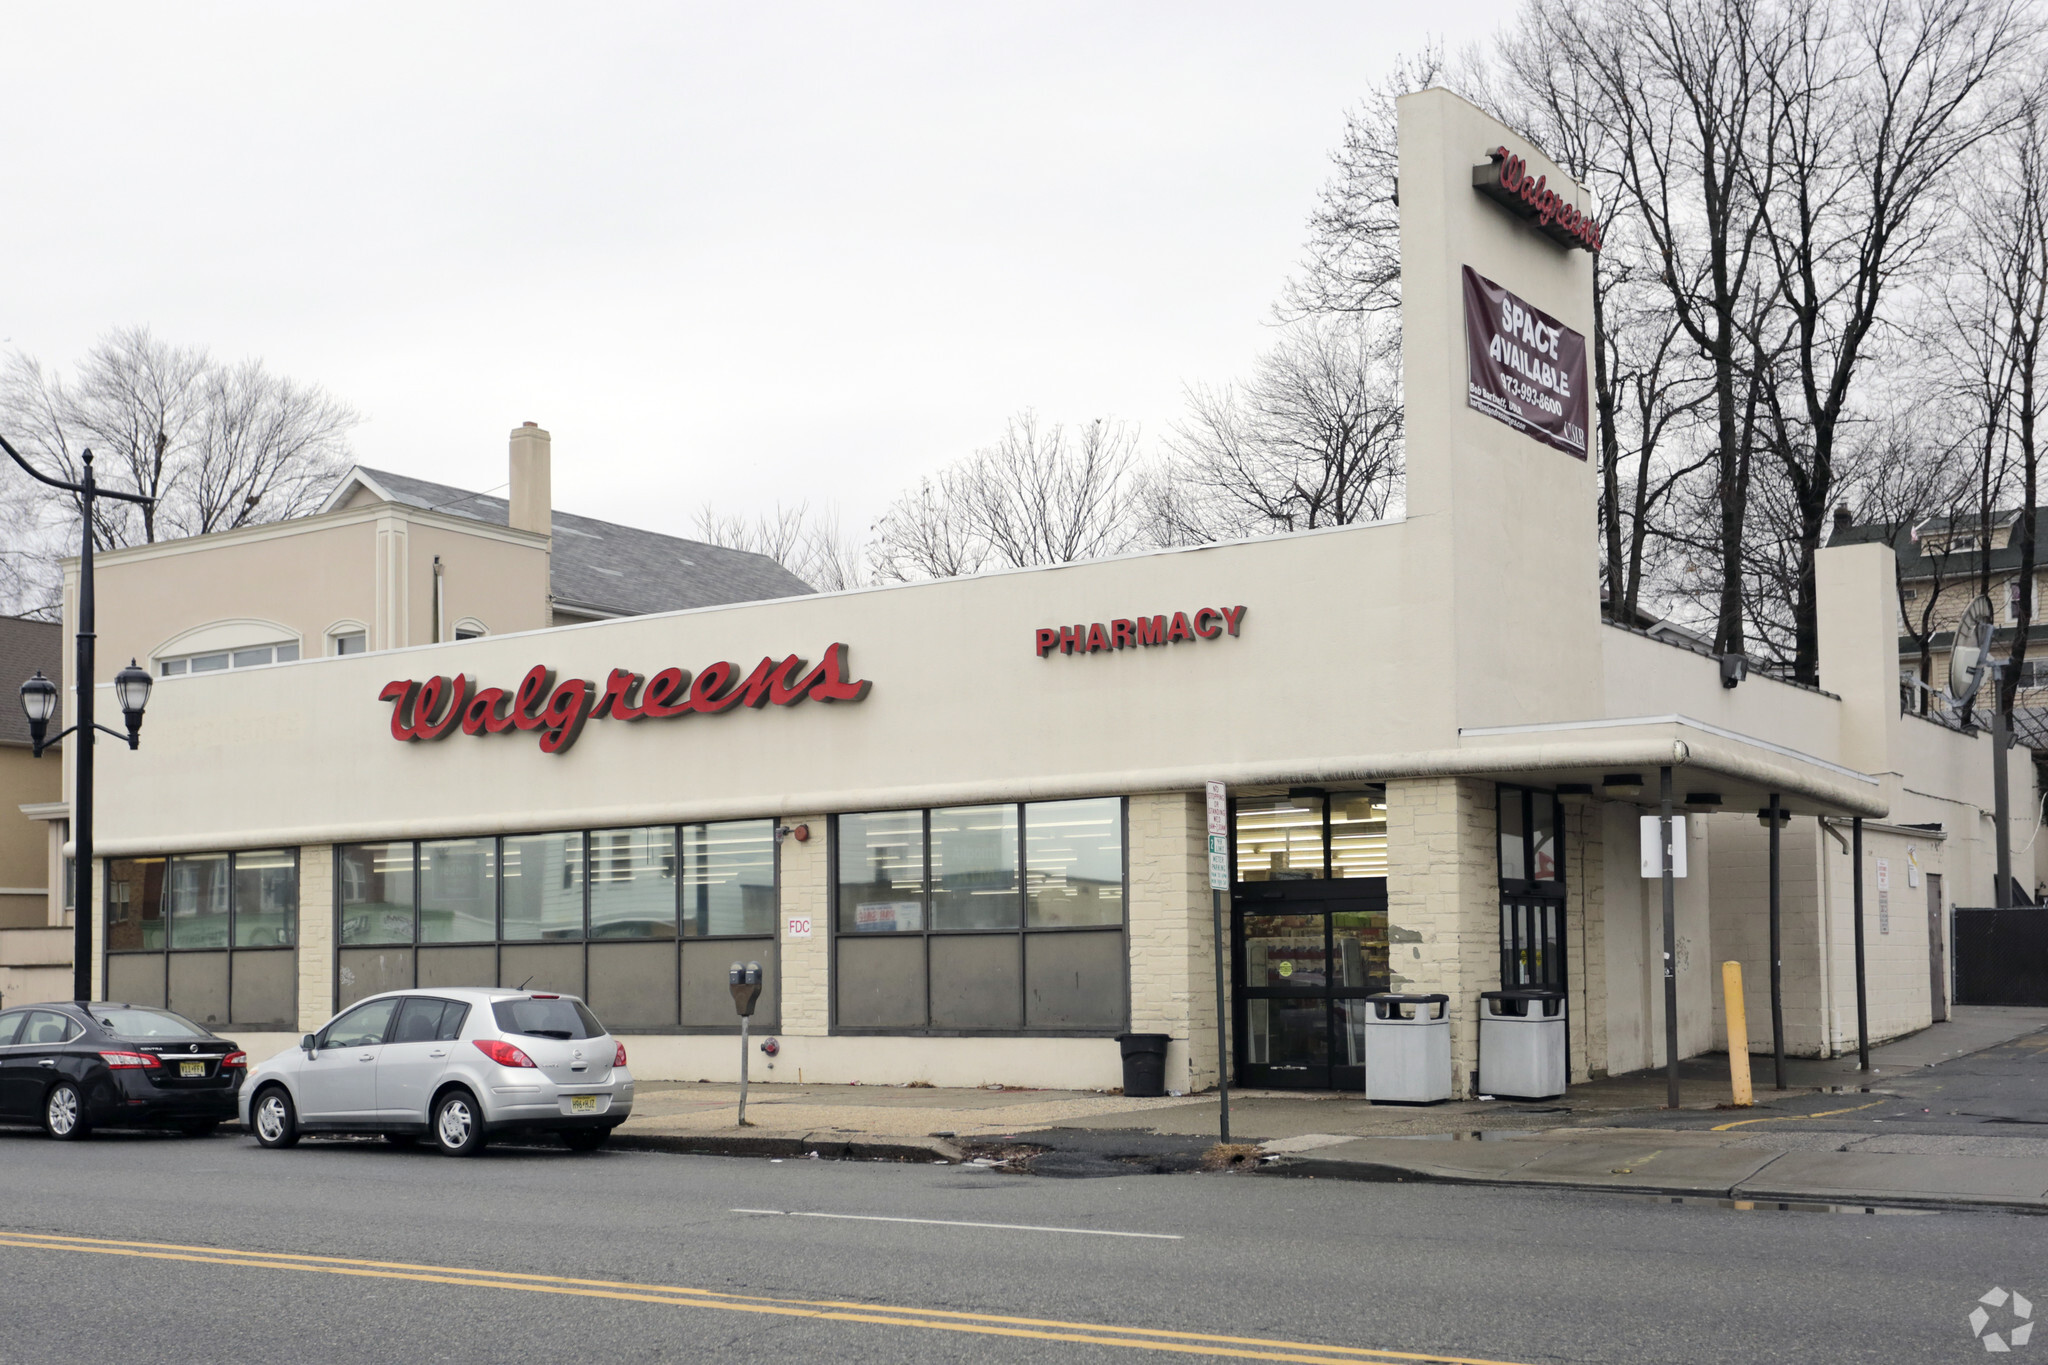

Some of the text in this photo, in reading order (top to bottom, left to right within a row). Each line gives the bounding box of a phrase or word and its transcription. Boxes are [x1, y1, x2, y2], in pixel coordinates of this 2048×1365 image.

[1497, 146, 1601, 251] Walgreens
[1502, 298, 1560, 361] SPACE
[1469, 382, 1481, 395] Bob
[1490, 334, 1570, 397] AVAILABLE
[1500, 373, 1562, 416] 973-993-8600
[1036, 605, 1247, 658] PHARMACY
[379, 642, 873, 754] Walgreens
[789, 920, 810, 933] FDC
